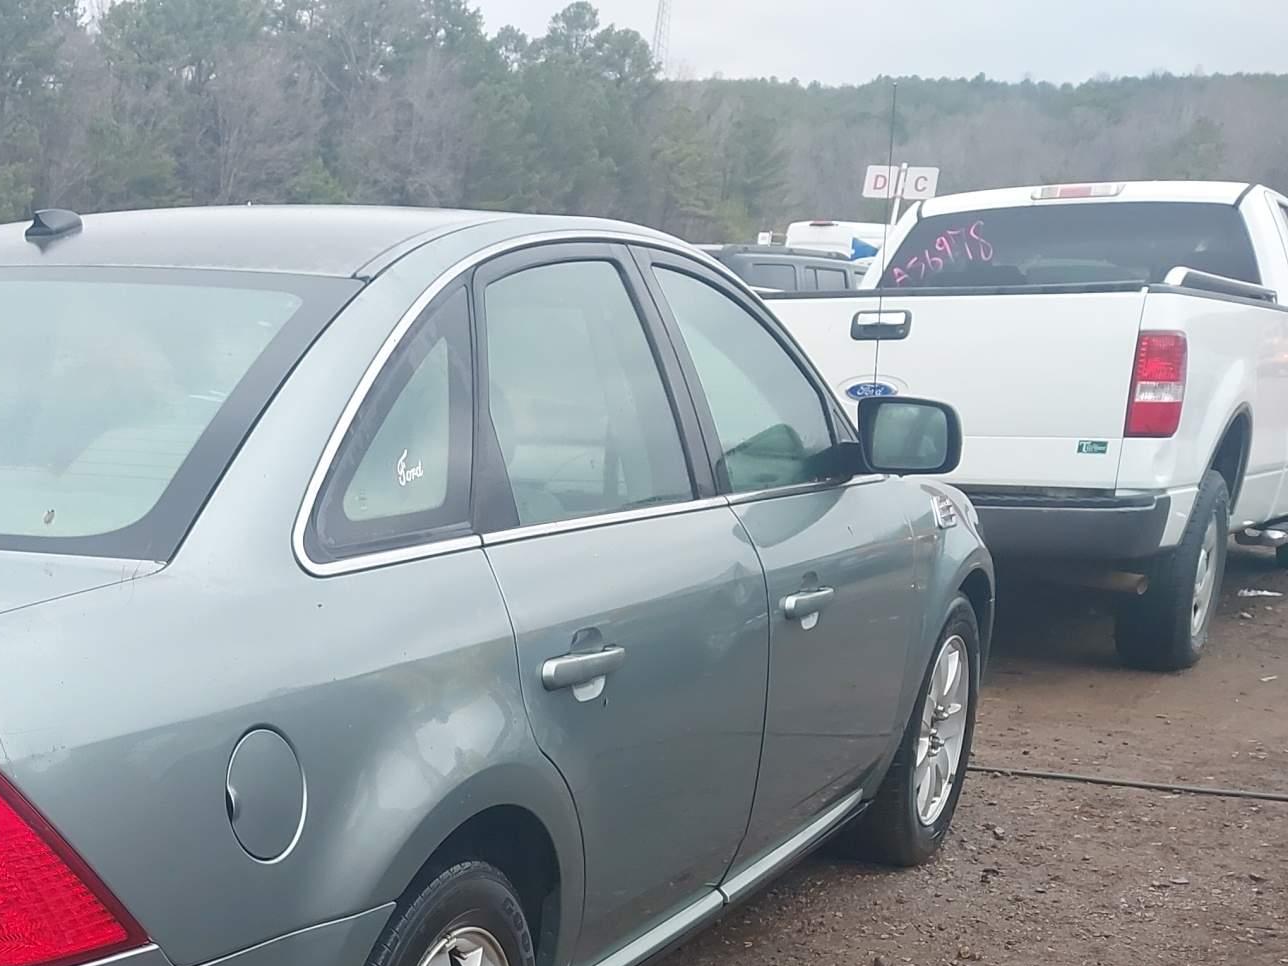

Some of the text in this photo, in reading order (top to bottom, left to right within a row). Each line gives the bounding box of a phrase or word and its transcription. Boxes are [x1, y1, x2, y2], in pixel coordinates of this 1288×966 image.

[873, 174, 888, 190] D
[914, 175, 929, 192] C
[397, 448, 424, 486] Ford
